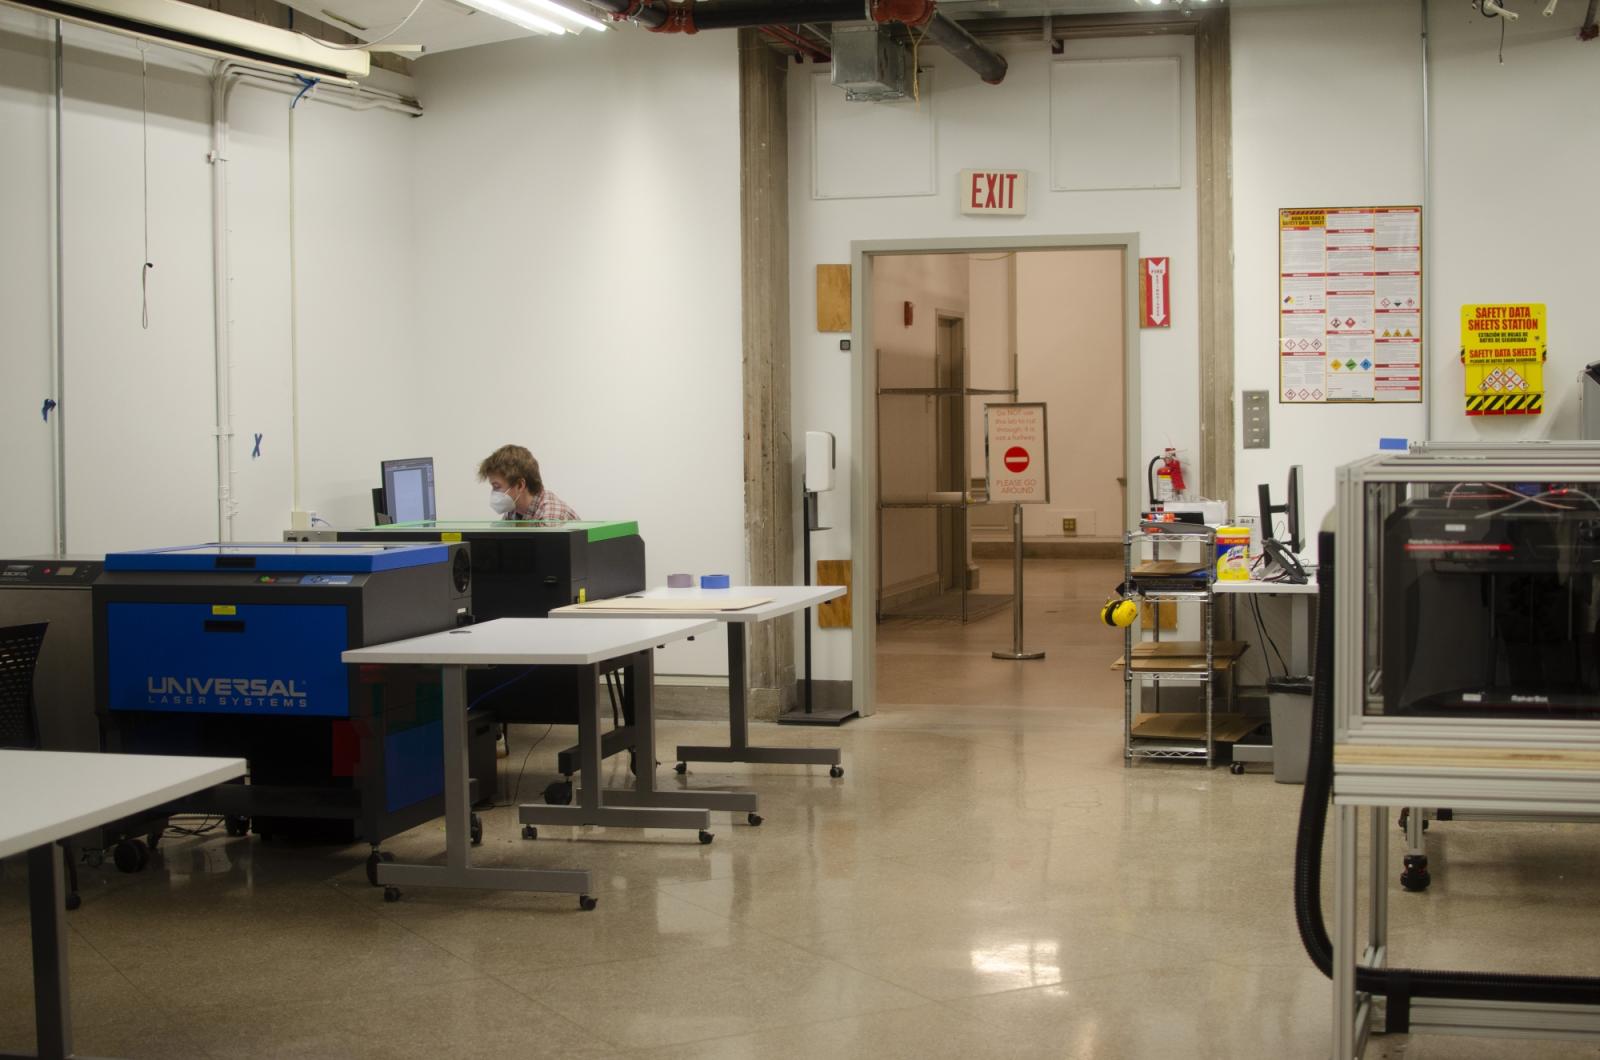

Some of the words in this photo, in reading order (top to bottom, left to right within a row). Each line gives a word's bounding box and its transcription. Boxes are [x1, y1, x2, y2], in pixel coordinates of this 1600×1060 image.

[971, 173, 1018, 209] EXIT
[1476, 307, 1507, 318] SAFETY
[1509, 307, 1531, 318] DATA
[1468, 319, 1500, 331] SHEETS
[1502, 318, 1538, 330] STATION
[1495, 349, 1510, 357] DATA
[1513, 348, 1536, 356] SHEETS
[996, 479, 1023, 487] PLEASE
[1024, 479, 1037, 487] GO
[1001, 486, 1034, 494] AROUND
[148, 676, 307, 697] UNIVERSAL
[148, 695, 206, 705] LASER
[219, 697, 307, 708] SYSTEMS
